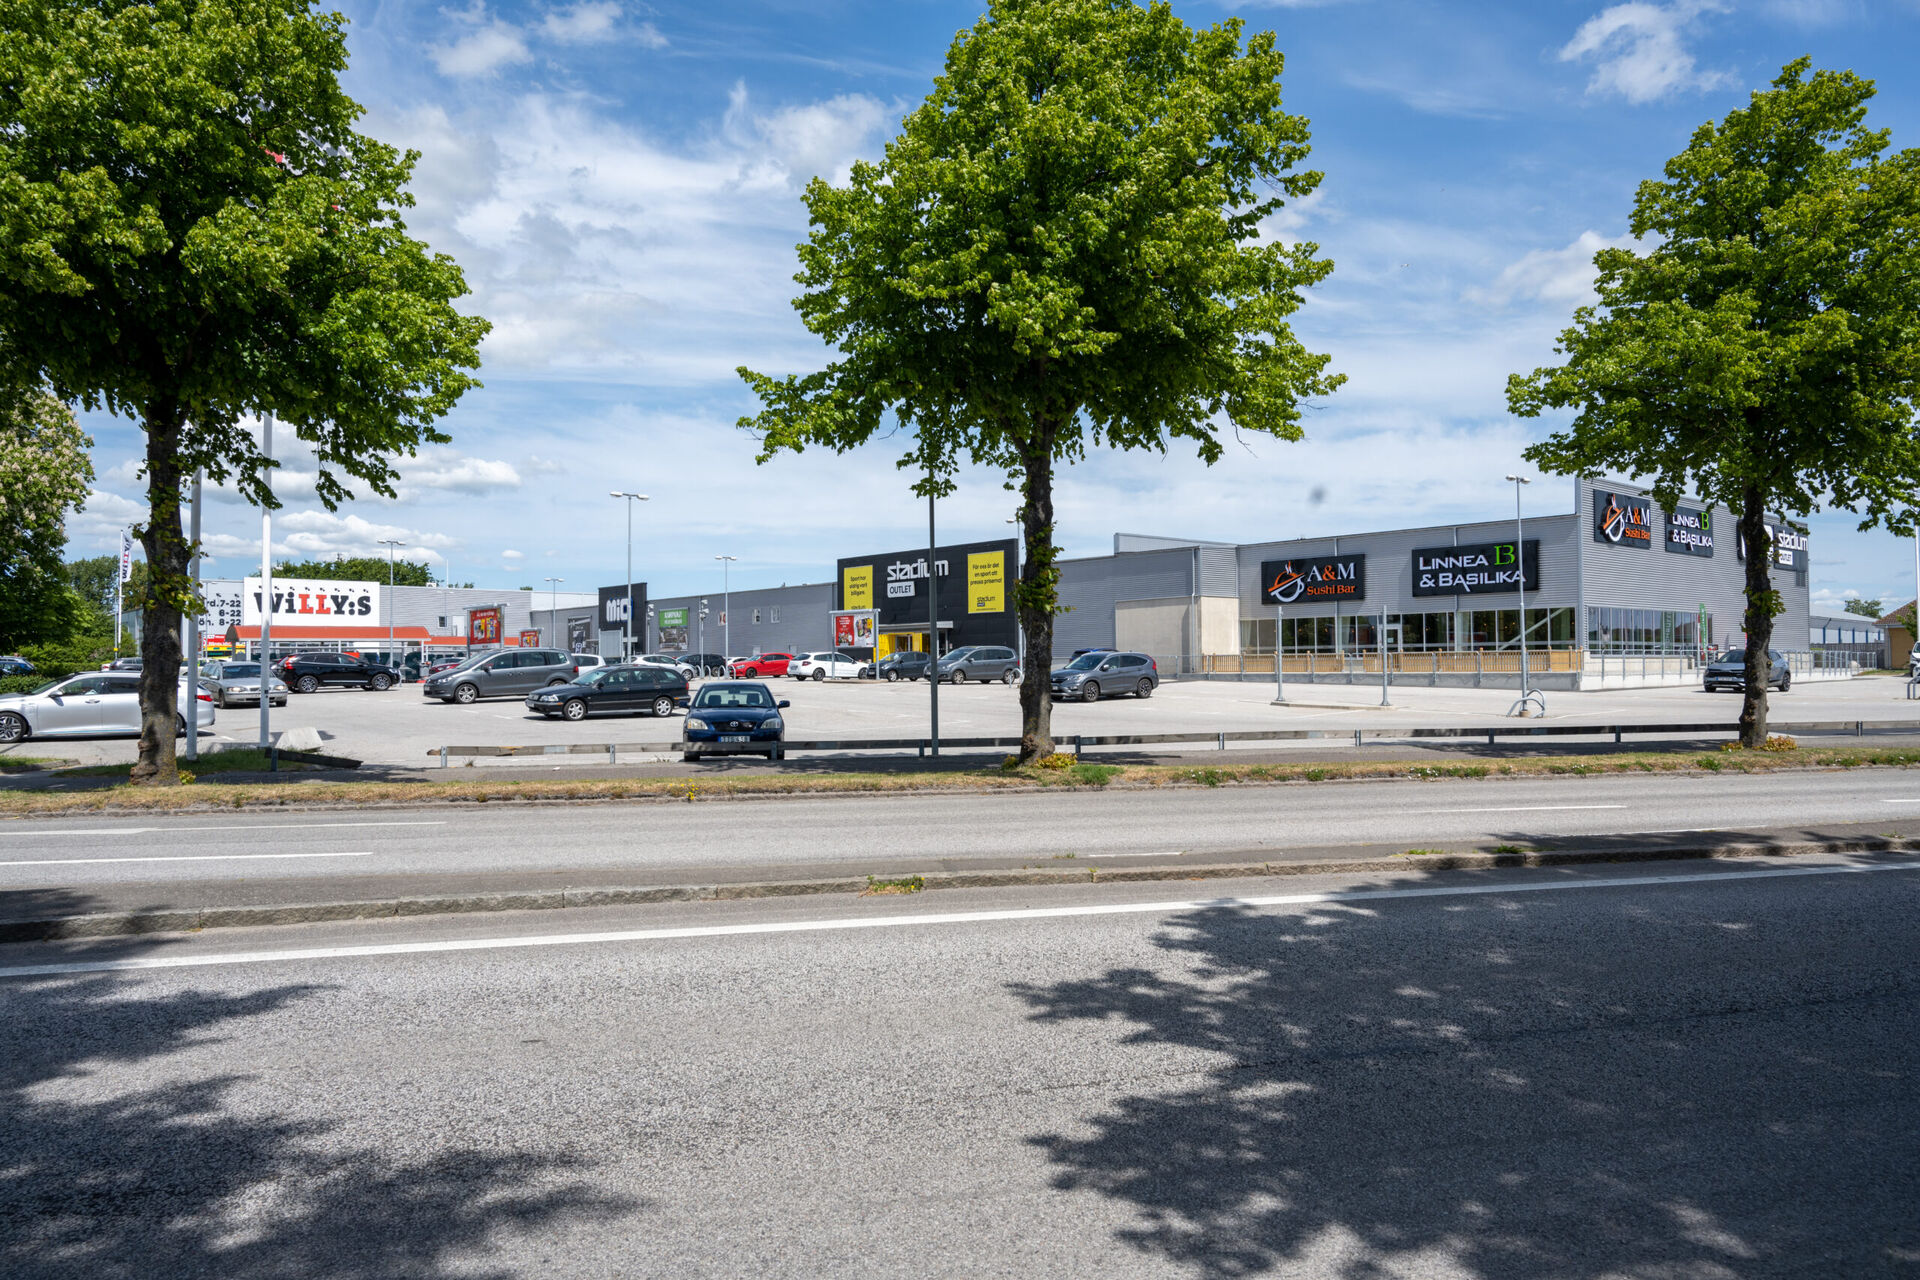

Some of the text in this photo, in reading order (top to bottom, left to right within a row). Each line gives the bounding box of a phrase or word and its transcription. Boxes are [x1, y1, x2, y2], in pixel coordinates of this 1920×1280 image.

[1625, 505, 1650, 526] A&M
[1672, 513, 1700, 529] LINNEA
[1625, 527, 1650, 540] Sushi Bar
[1672, 529, 1713, 551] & BASILIKA
[1778, 530, 1808, 551] stadium
[887, 558, 949, 581] stadium
[1419, 554, 1489, 570] LINNEA
[1307, 562, 1355, 581] A&M
[1420, 570, 1526, 592] & BASILIKA
[889, 585, 912, 595] OUTLET
[1306, 584, 1356, 596] Sushi Bar
[253, 591, 371, 616] WiLLY:S
[219, 609, 242, 617] 8-22
[219, 618, 242, 626] 8-22
